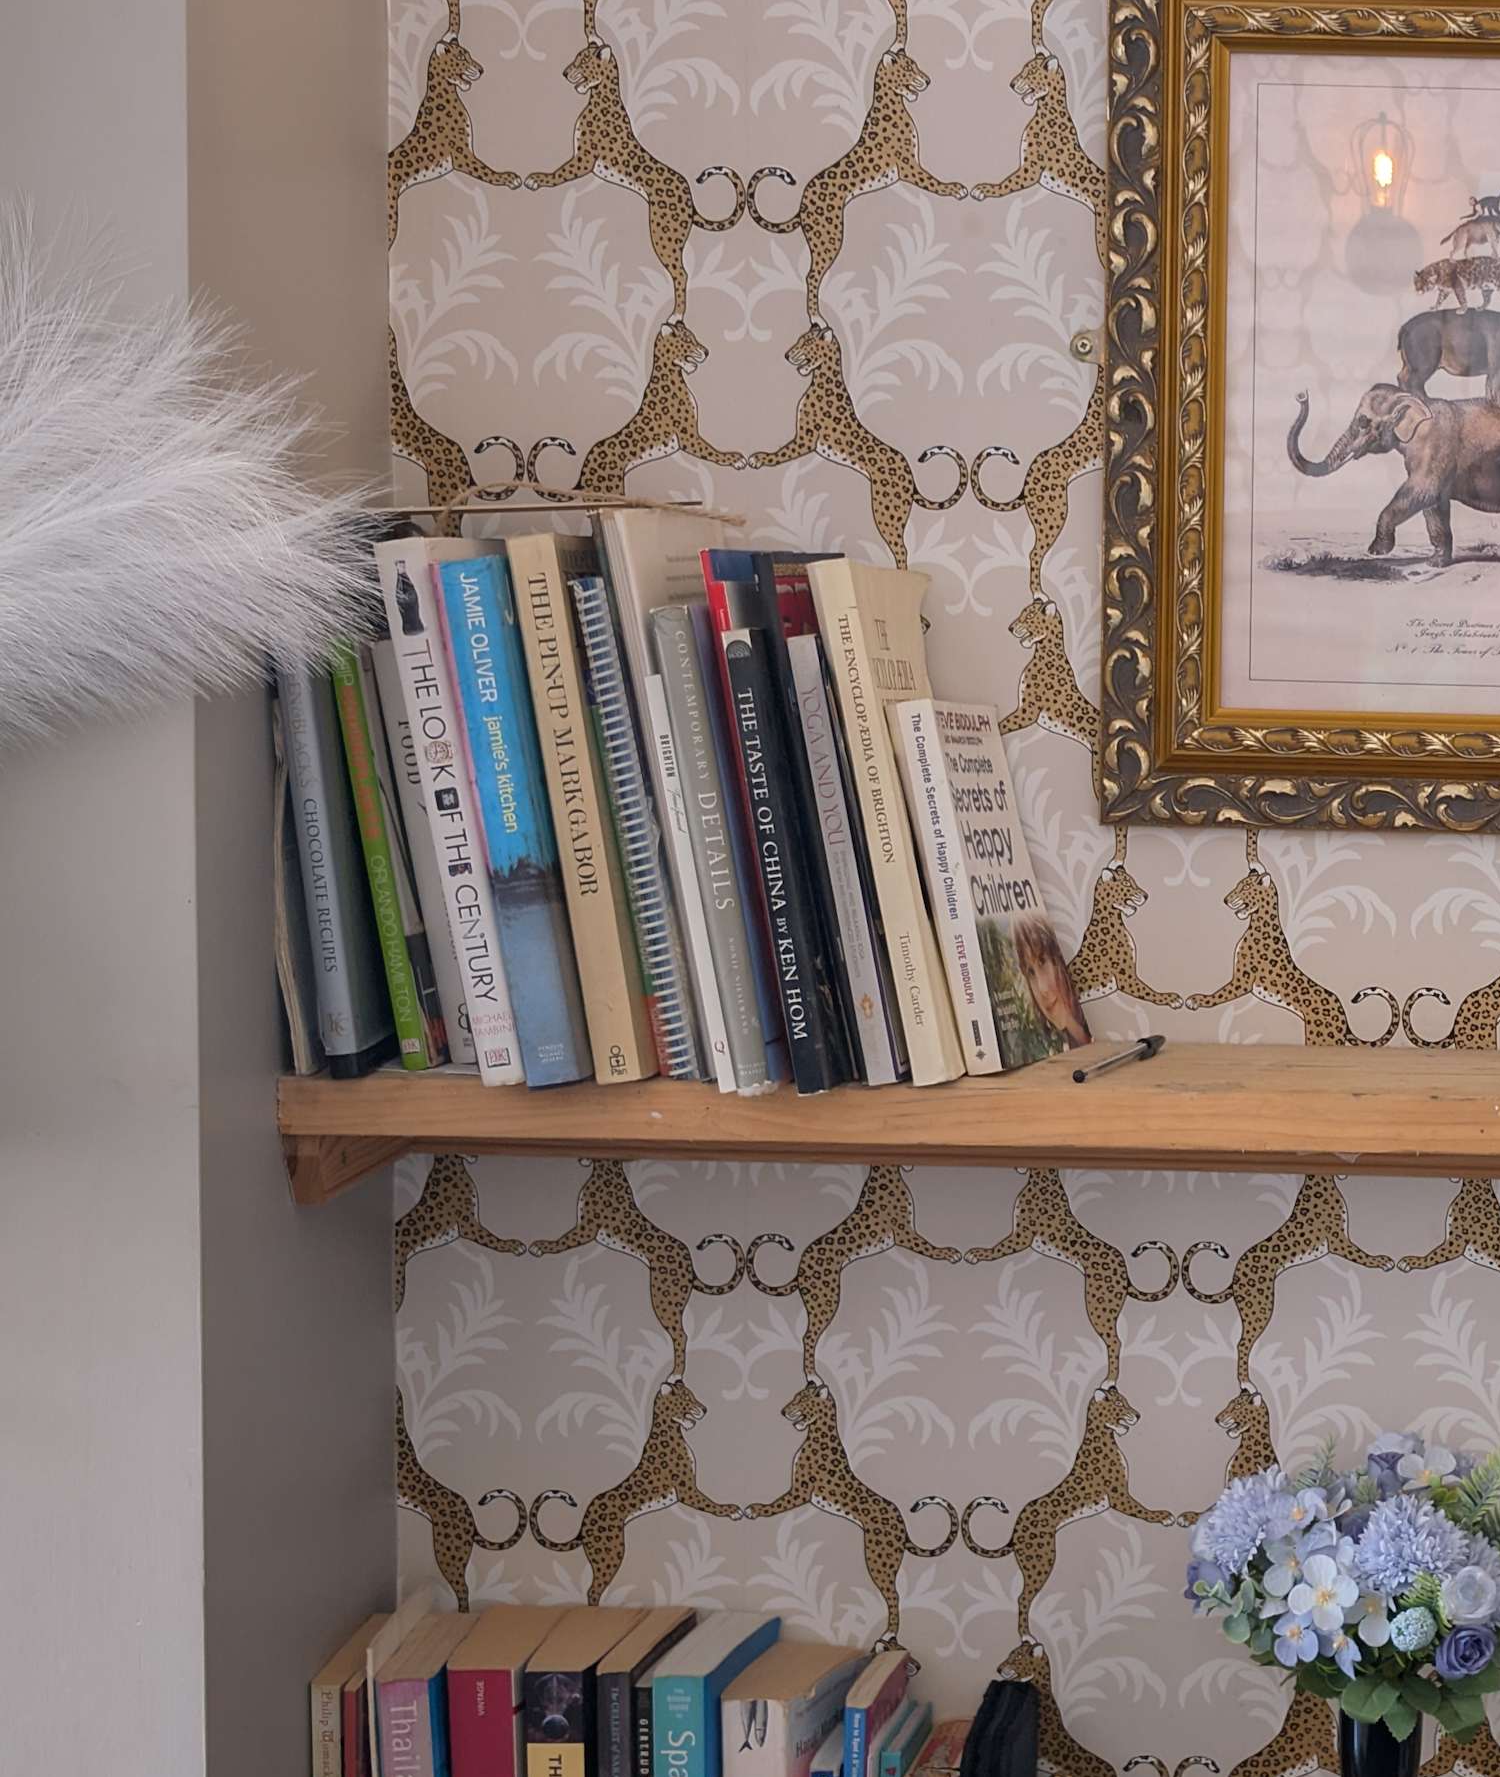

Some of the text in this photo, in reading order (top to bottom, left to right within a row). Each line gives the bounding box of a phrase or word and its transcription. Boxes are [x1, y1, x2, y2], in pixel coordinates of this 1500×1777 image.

[838, 614, 855, 646] THE
[460, 572, 519, 833] JAMIE OLIVER jamie's kitchen
[527, 572, 598, 897] THE PIN-UP MARK GABOR
[659, 734, 676, 777] BRIGHTON
[675, 630, 710, 781] CONTEMPORARY
[698, 791, 735, 911] DETAILS
[801, 686, 845, 846] YOGA AND YOU
[867, 766, 880, 786] OF
[958, 755, 993, 776] Complete
[403, 638, 440, 699] THE
[455, 884, 498, 1003] CENTURY
[871, 787, 896, 864] BRIGHTON
[911, 713, 959, 920] The Complete Secrets of Happy Children
[951, 780, 1009, 814] Secrets of
[738, 687, 808, 1040] THE TASTE OF CHINA BY KEN HOM
[960, 821, 1014, 868] Happy
[303, 798, 338, 972] CHOCOLATE RECIPES
[970, 874, 1039, 917] Children
[370, 854, 413, 1022] ORLANDO HAMILTON
[954, 934, 976, 1005] STEVE BIDDULPH
[900, 932, 924, 1027] Timothy Carder
[320, 1690, 334, 1726] Philip
[476, 1680, 486, 1716] VINTAGE
